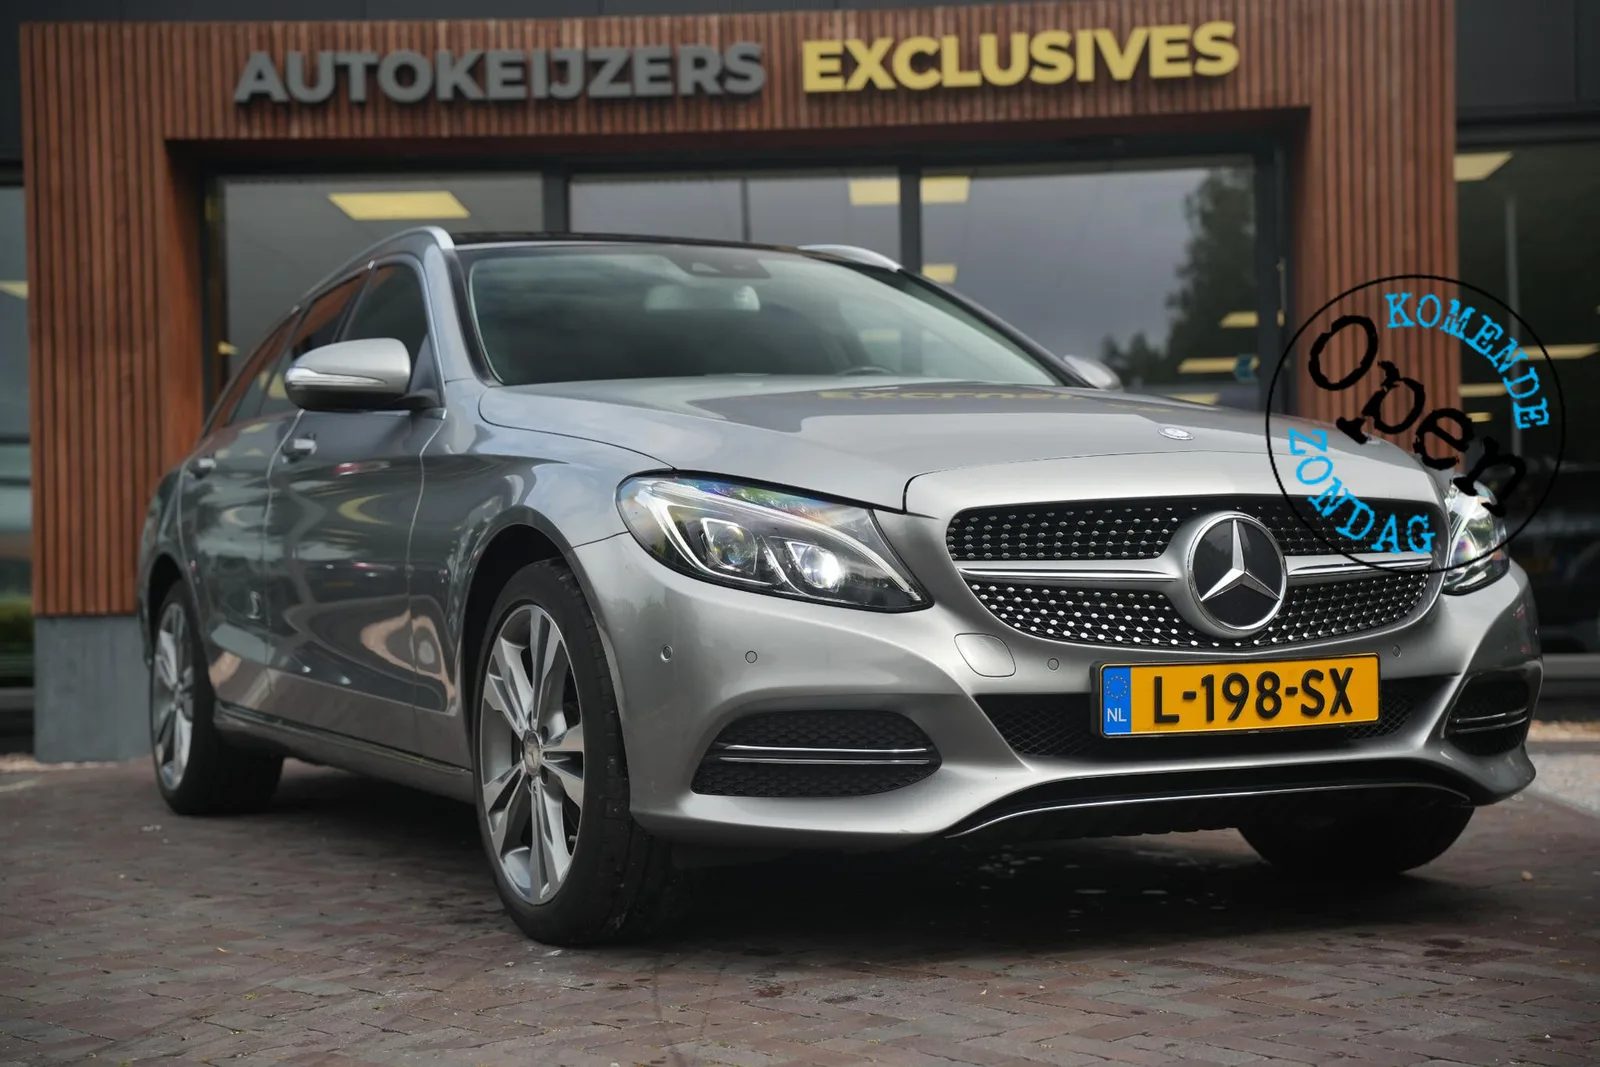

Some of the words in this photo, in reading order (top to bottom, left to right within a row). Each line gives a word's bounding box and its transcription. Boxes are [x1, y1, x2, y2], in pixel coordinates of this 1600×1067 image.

[234, 42, 766, 103] AUTOKEIJZERS
[803, 22, 1240, 92] EXCLUSIVES
[1107, 707, 1127, 722] NL
[1153, 667, 1354, 724] L-198-SX
